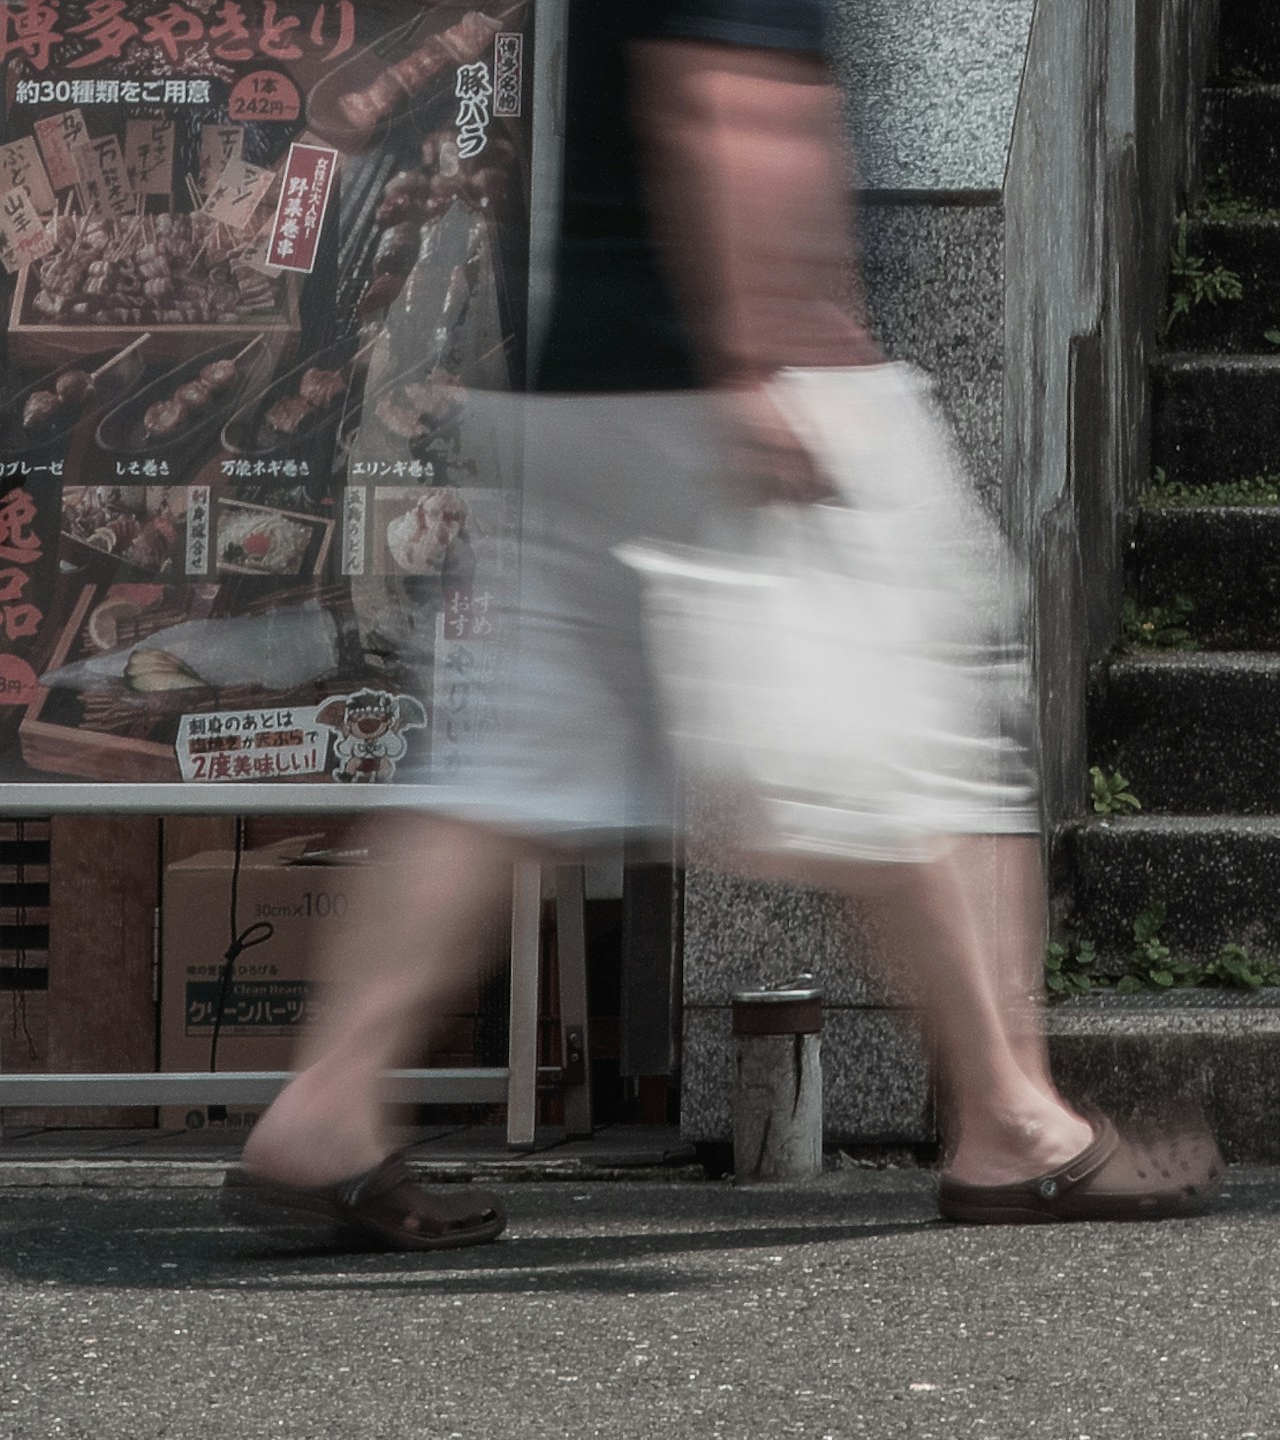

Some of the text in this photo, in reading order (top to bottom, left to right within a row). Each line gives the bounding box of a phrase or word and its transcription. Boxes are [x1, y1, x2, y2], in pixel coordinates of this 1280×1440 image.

[15, 79, 211, 105] 約30種類をご用意
[251, 77, 279, 94] 1本
[456, 61, 492, 159] 豚バラ
[115, 460, 170, 477] しそ巻き
[220, 459, 310, 477] 万能ネギ巻き
[352, 459, 436, 477] エリンギ巻き
[188, 710, 294, 735] 刺身のあとは
[233, 983, 266, 995] Clean
